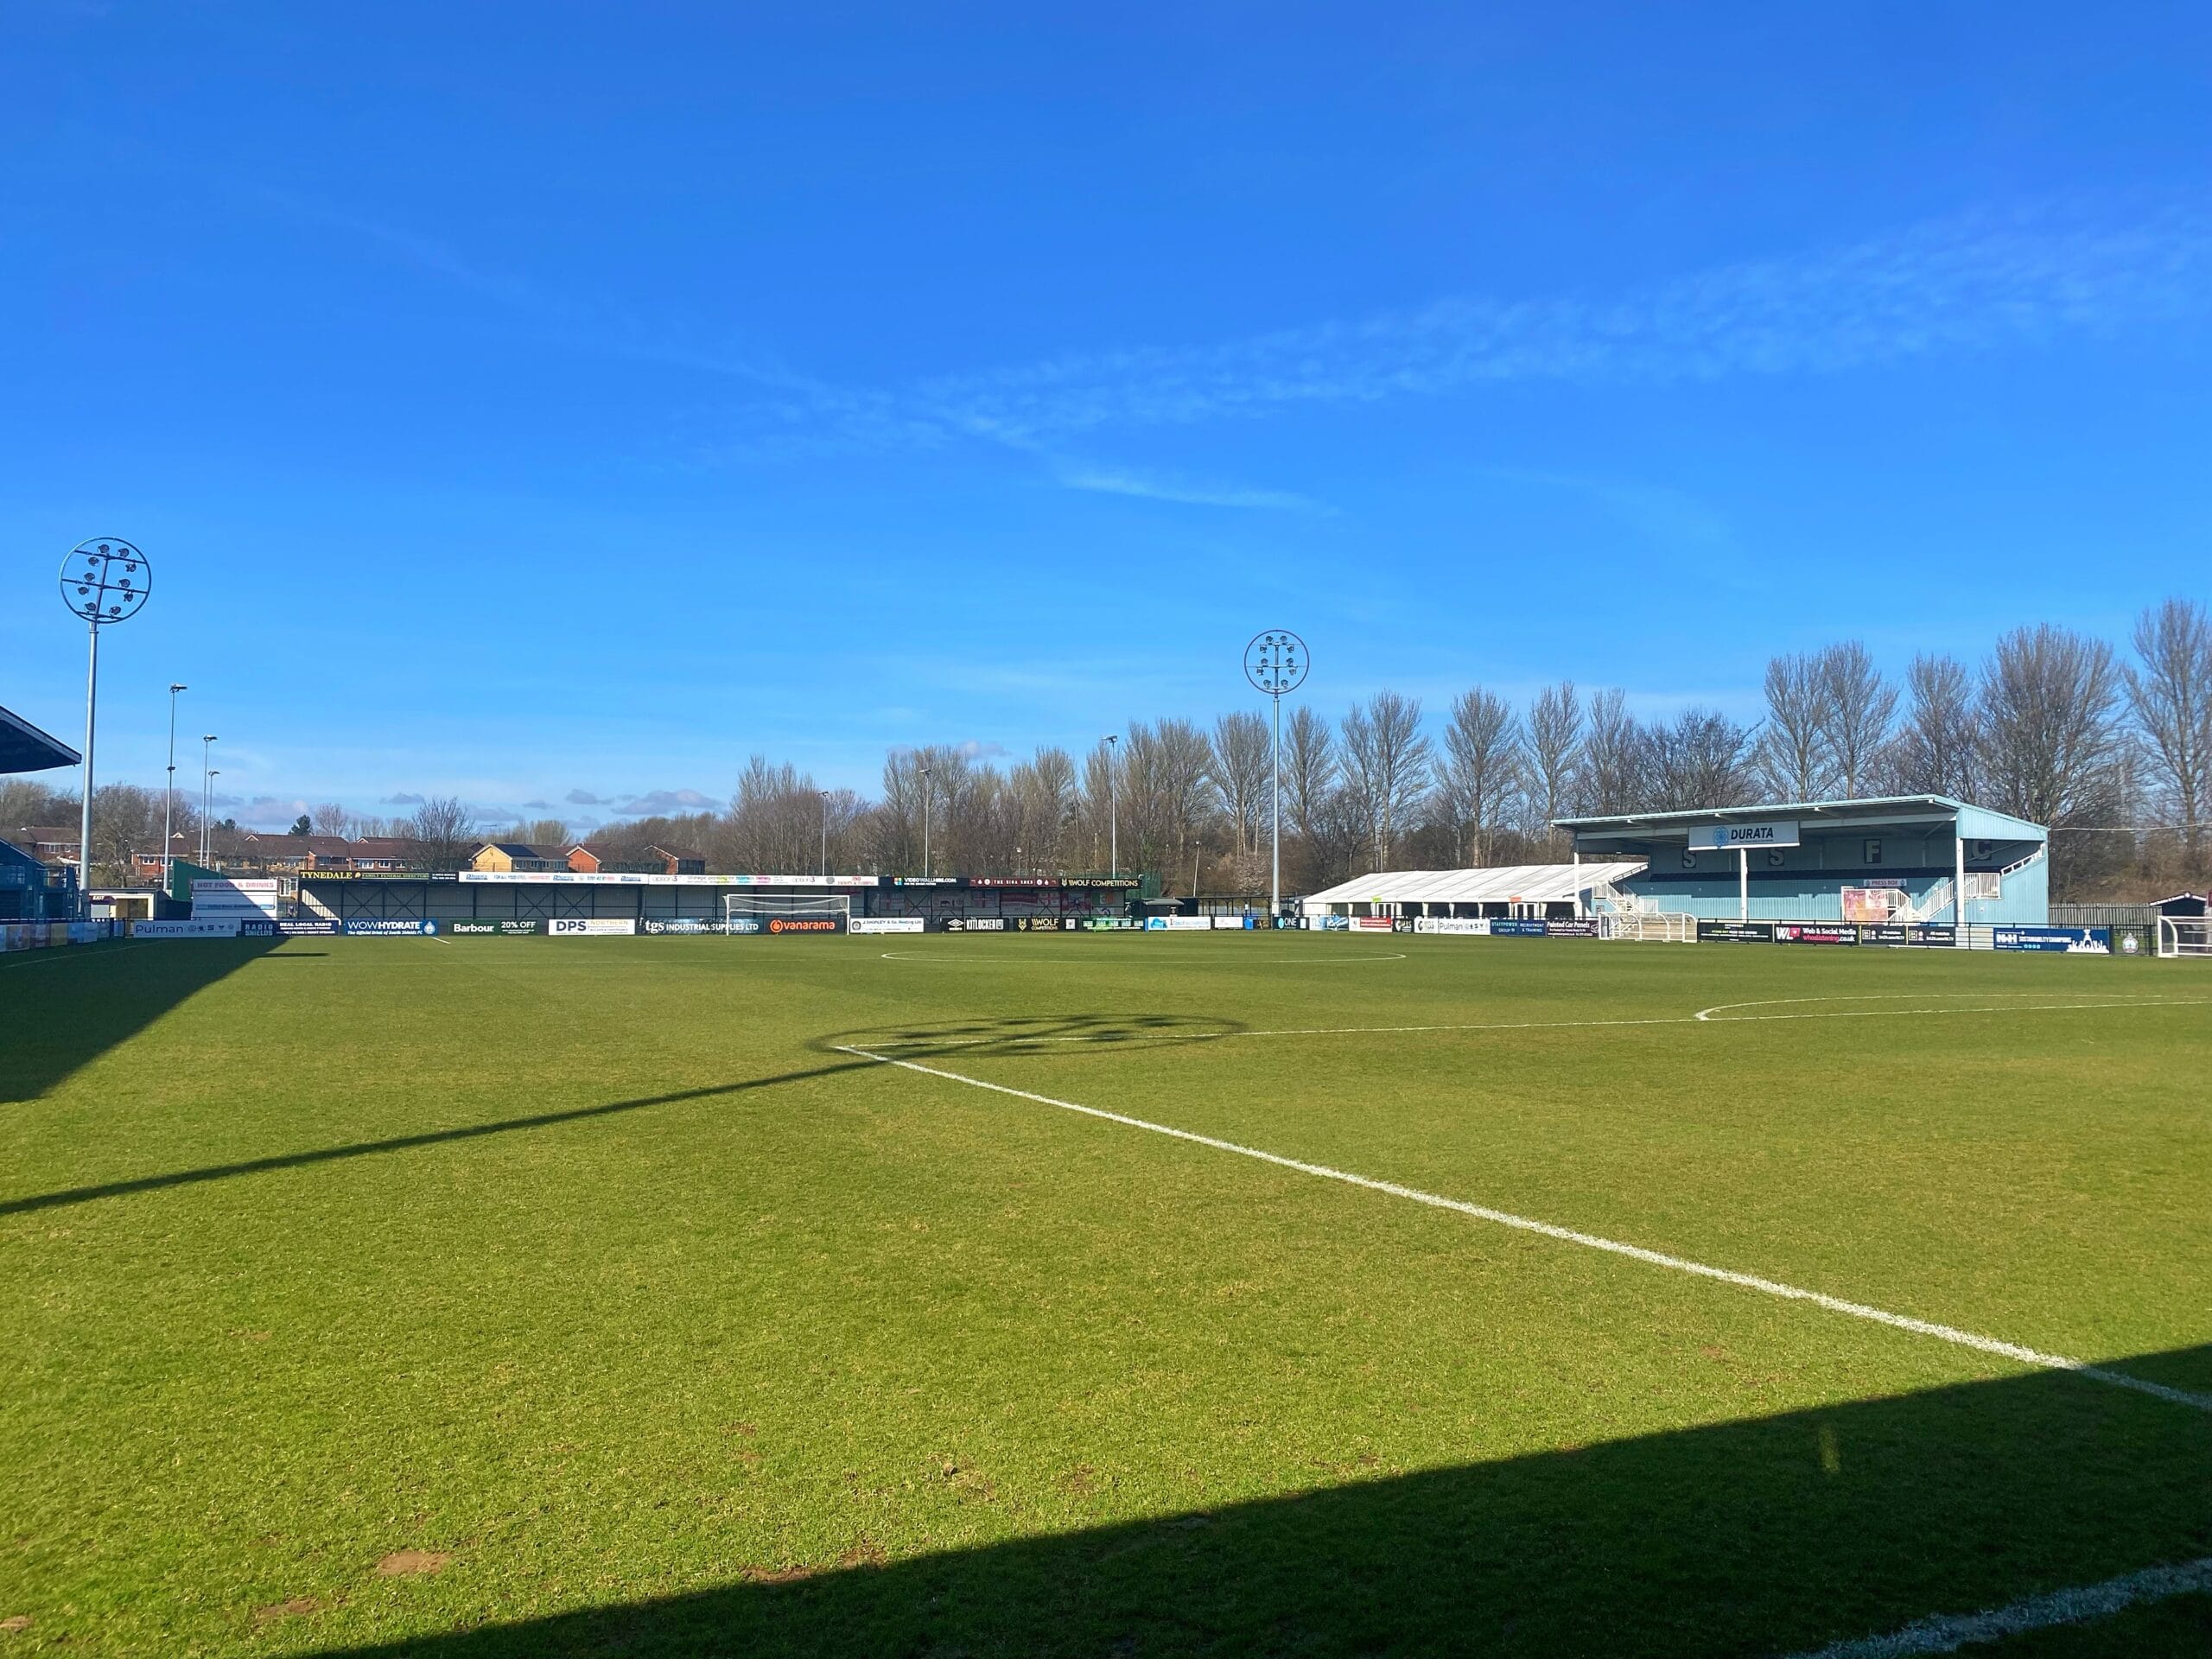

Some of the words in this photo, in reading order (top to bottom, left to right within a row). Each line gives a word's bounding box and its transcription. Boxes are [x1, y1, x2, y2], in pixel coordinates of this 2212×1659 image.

[1731, 827, 1774, 841] DURATA
[1683, 848, 1696, 868] S
[1770, 848, 1783, 866] S
[1866, 840, 1880, 862] F
[301, 871, 353, 880] TYNEDALE
[556, 920, 587, 931] DPS
[784, 921, 836, 930] vanarama
[966, 918, 996, 930] KITLOCKER
[1284, 918, 1297, 926] ONE
[1440, 922, 1463, 931] Pulman
[136, 925, 183, 934] Pulman
[454, 924, 493, 932] Barbour
[645, 920, 664, 934] tgs
